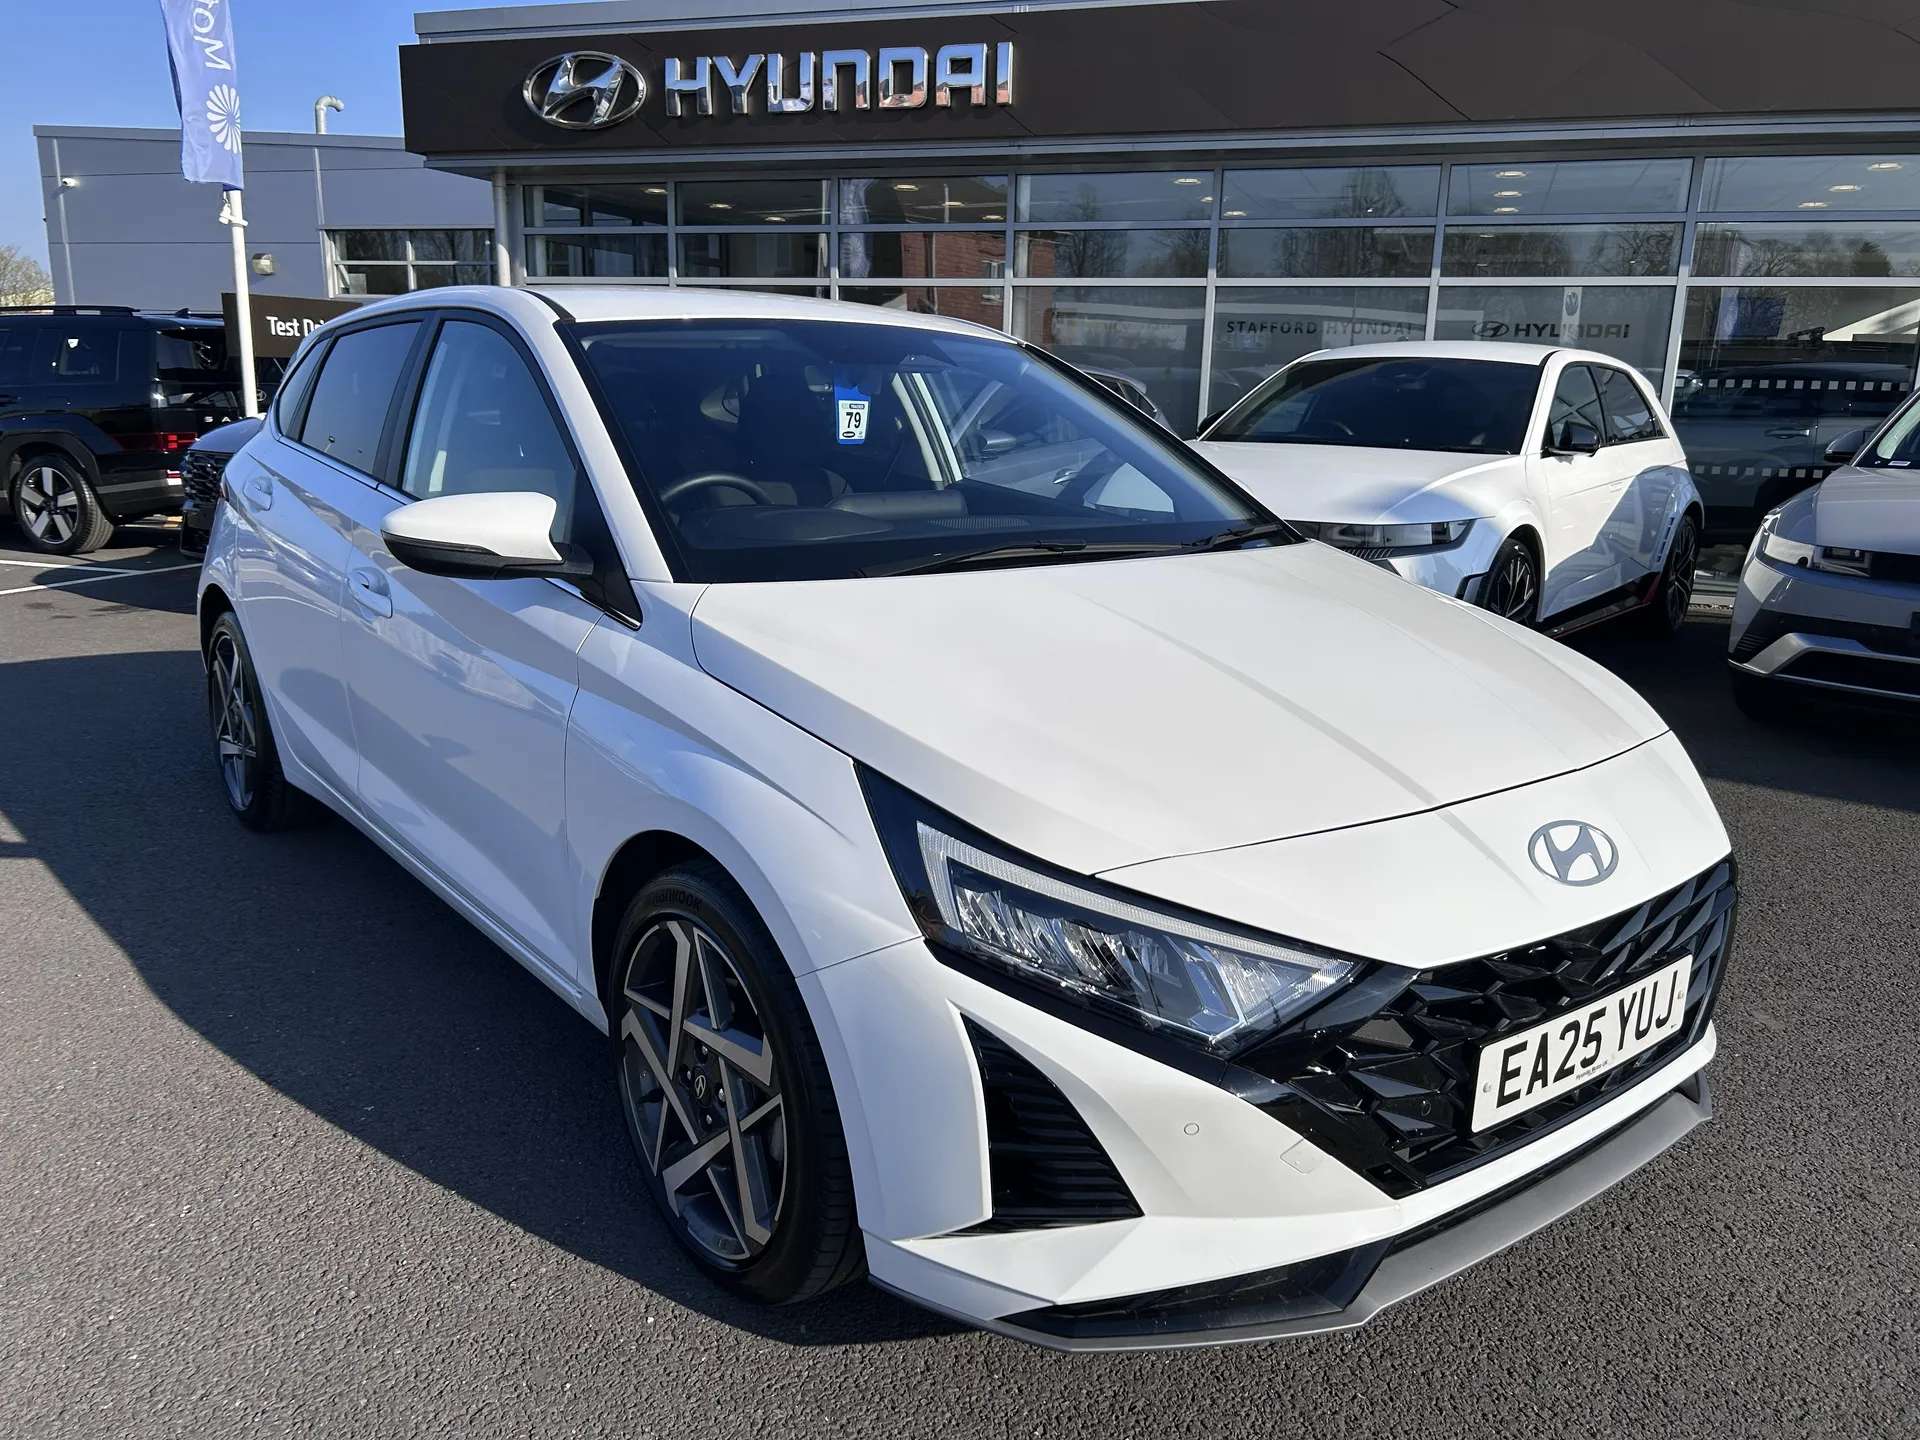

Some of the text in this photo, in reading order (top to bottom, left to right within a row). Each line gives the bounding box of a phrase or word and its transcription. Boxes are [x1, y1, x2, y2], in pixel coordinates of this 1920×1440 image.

[664, 41, 1014, 117] HYUNDAI
[265, 316, 300, 336] Test
[1226, 320, 1412, 335] STAFFORD HYUNDAI
[845, 411, 861, 429] 79
[1496, 970, 1679, 1109] EA25 YUJ
